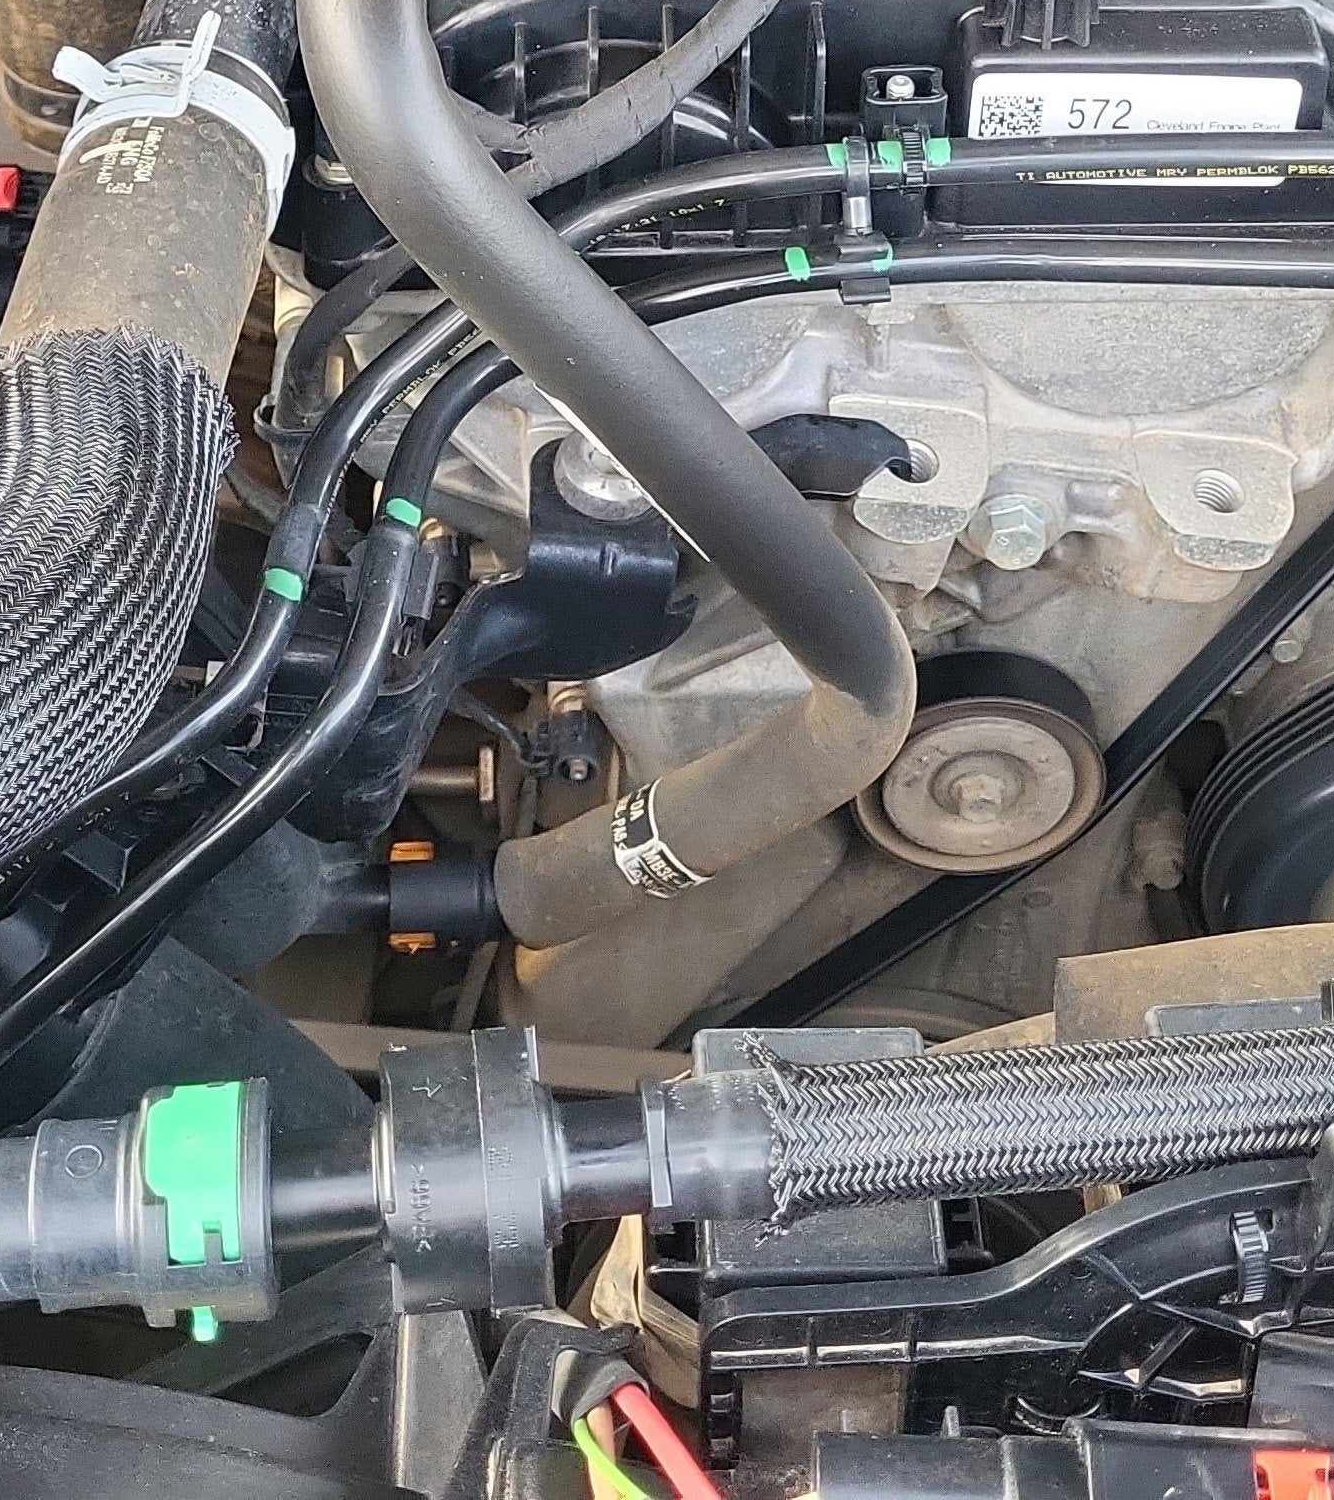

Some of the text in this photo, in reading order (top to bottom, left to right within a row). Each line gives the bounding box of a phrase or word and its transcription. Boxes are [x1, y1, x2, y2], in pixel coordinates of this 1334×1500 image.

[1068, 98, 1133, 131] 572
[1146, 119, 1204, 131] Cleveland
[1016, 171, 1036, 182] TI
[1046, 168, 1147, 180] AUTOMOTIVE
[1156, 167, 1188, 177] MRY
[1196, 165, 1279, 177] PERMBLOK
